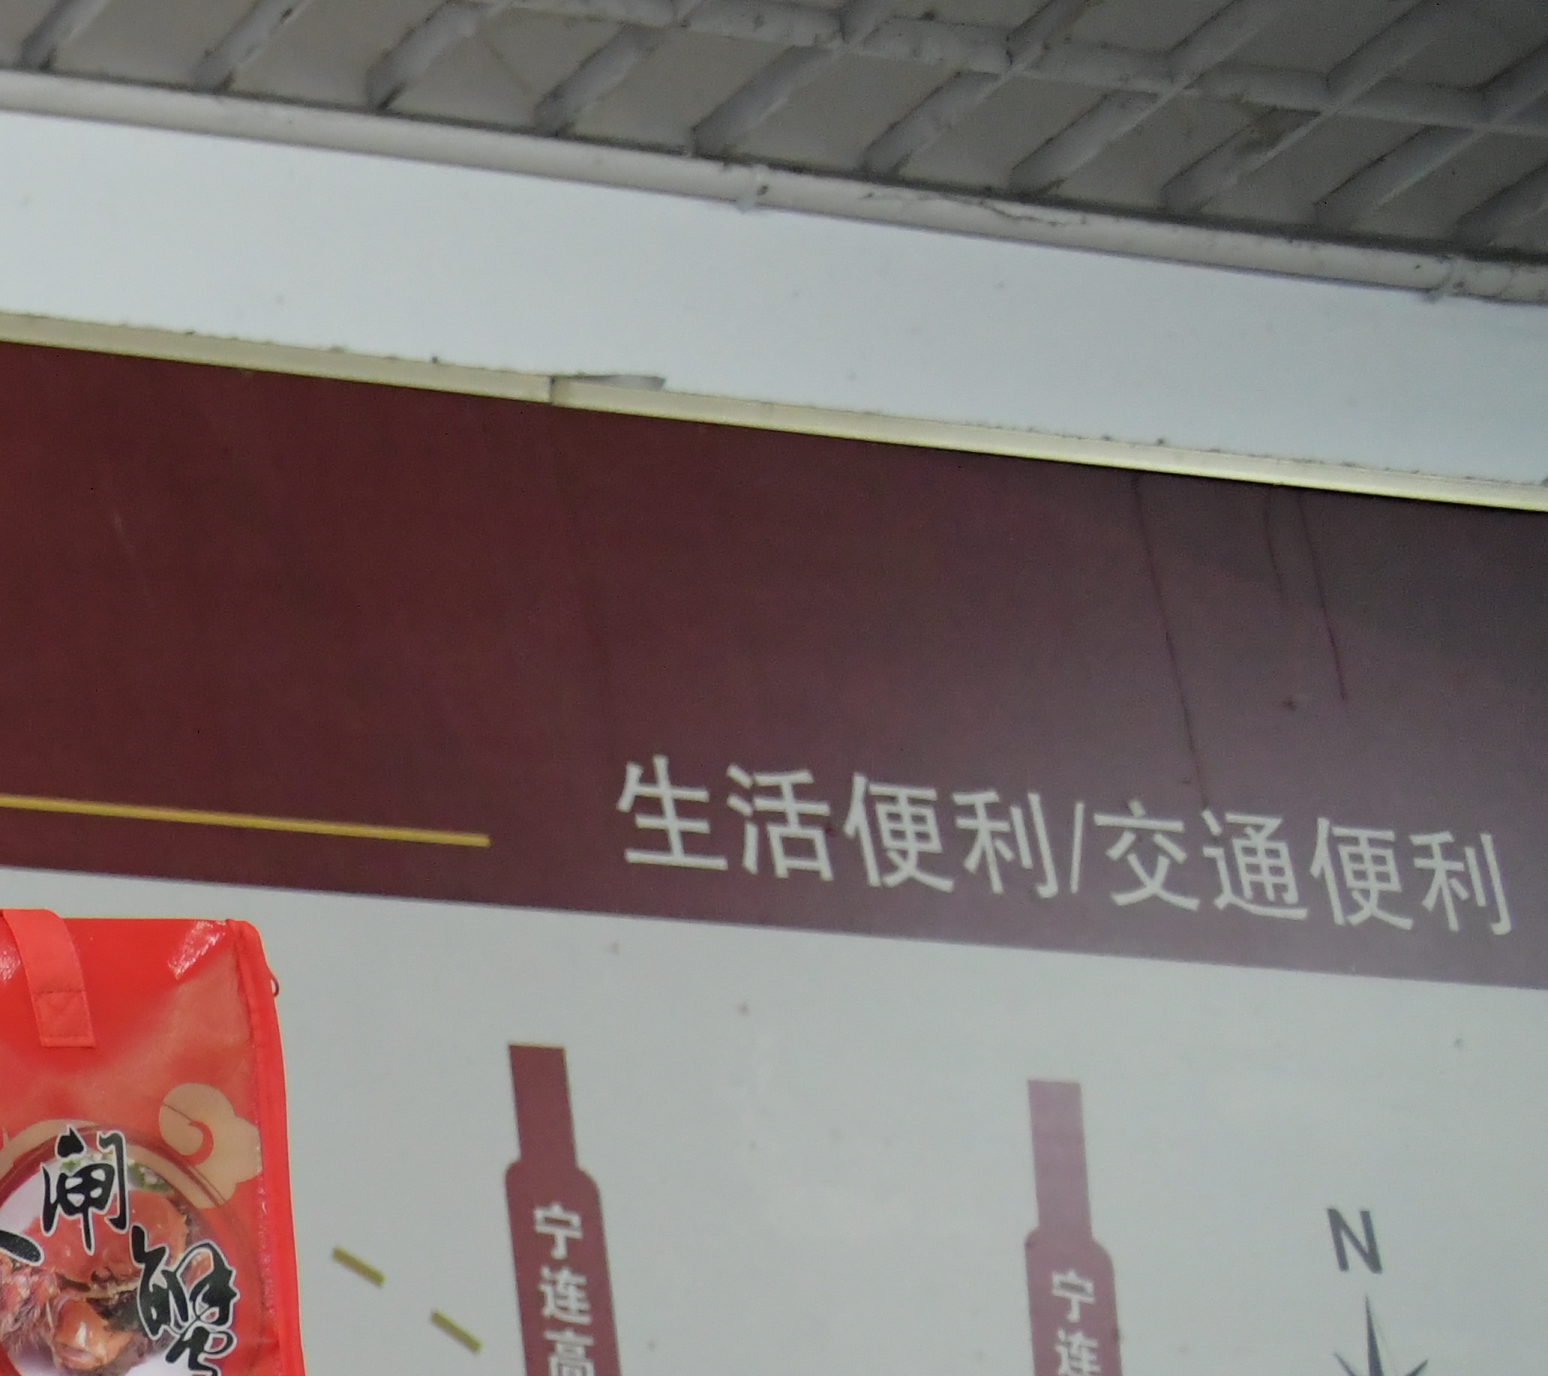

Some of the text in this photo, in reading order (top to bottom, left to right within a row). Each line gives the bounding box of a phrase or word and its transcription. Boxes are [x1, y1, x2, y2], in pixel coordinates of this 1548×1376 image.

[617, 755, 1514, 935] 生活便利/交通便利
[1327, 1208, 1383, 1274] N
